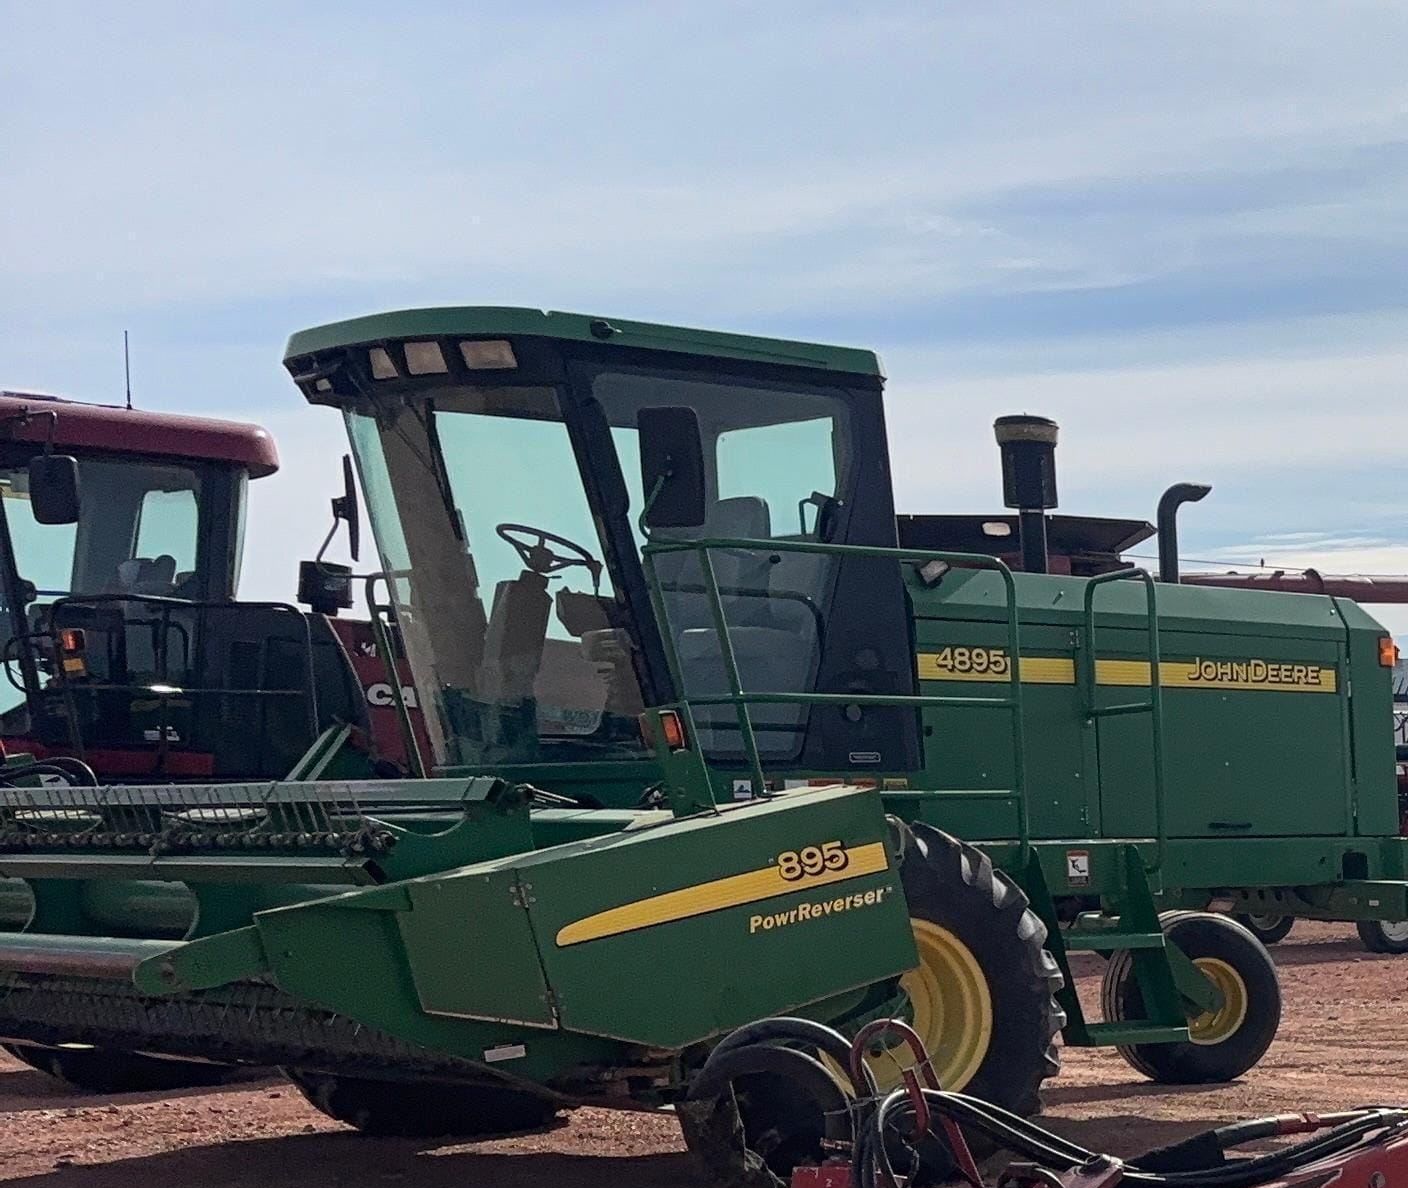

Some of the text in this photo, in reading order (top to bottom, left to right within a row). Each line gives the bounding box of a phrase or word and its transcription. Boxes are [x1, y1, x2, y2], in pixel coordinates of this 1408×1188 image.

[936, 647, 1007, 674] 4895
[1188, 657, 1321, 685] JOHN DEERE
[777, 841, 848, 881] 895
[749, 887, 885, 934] PowrReverser
